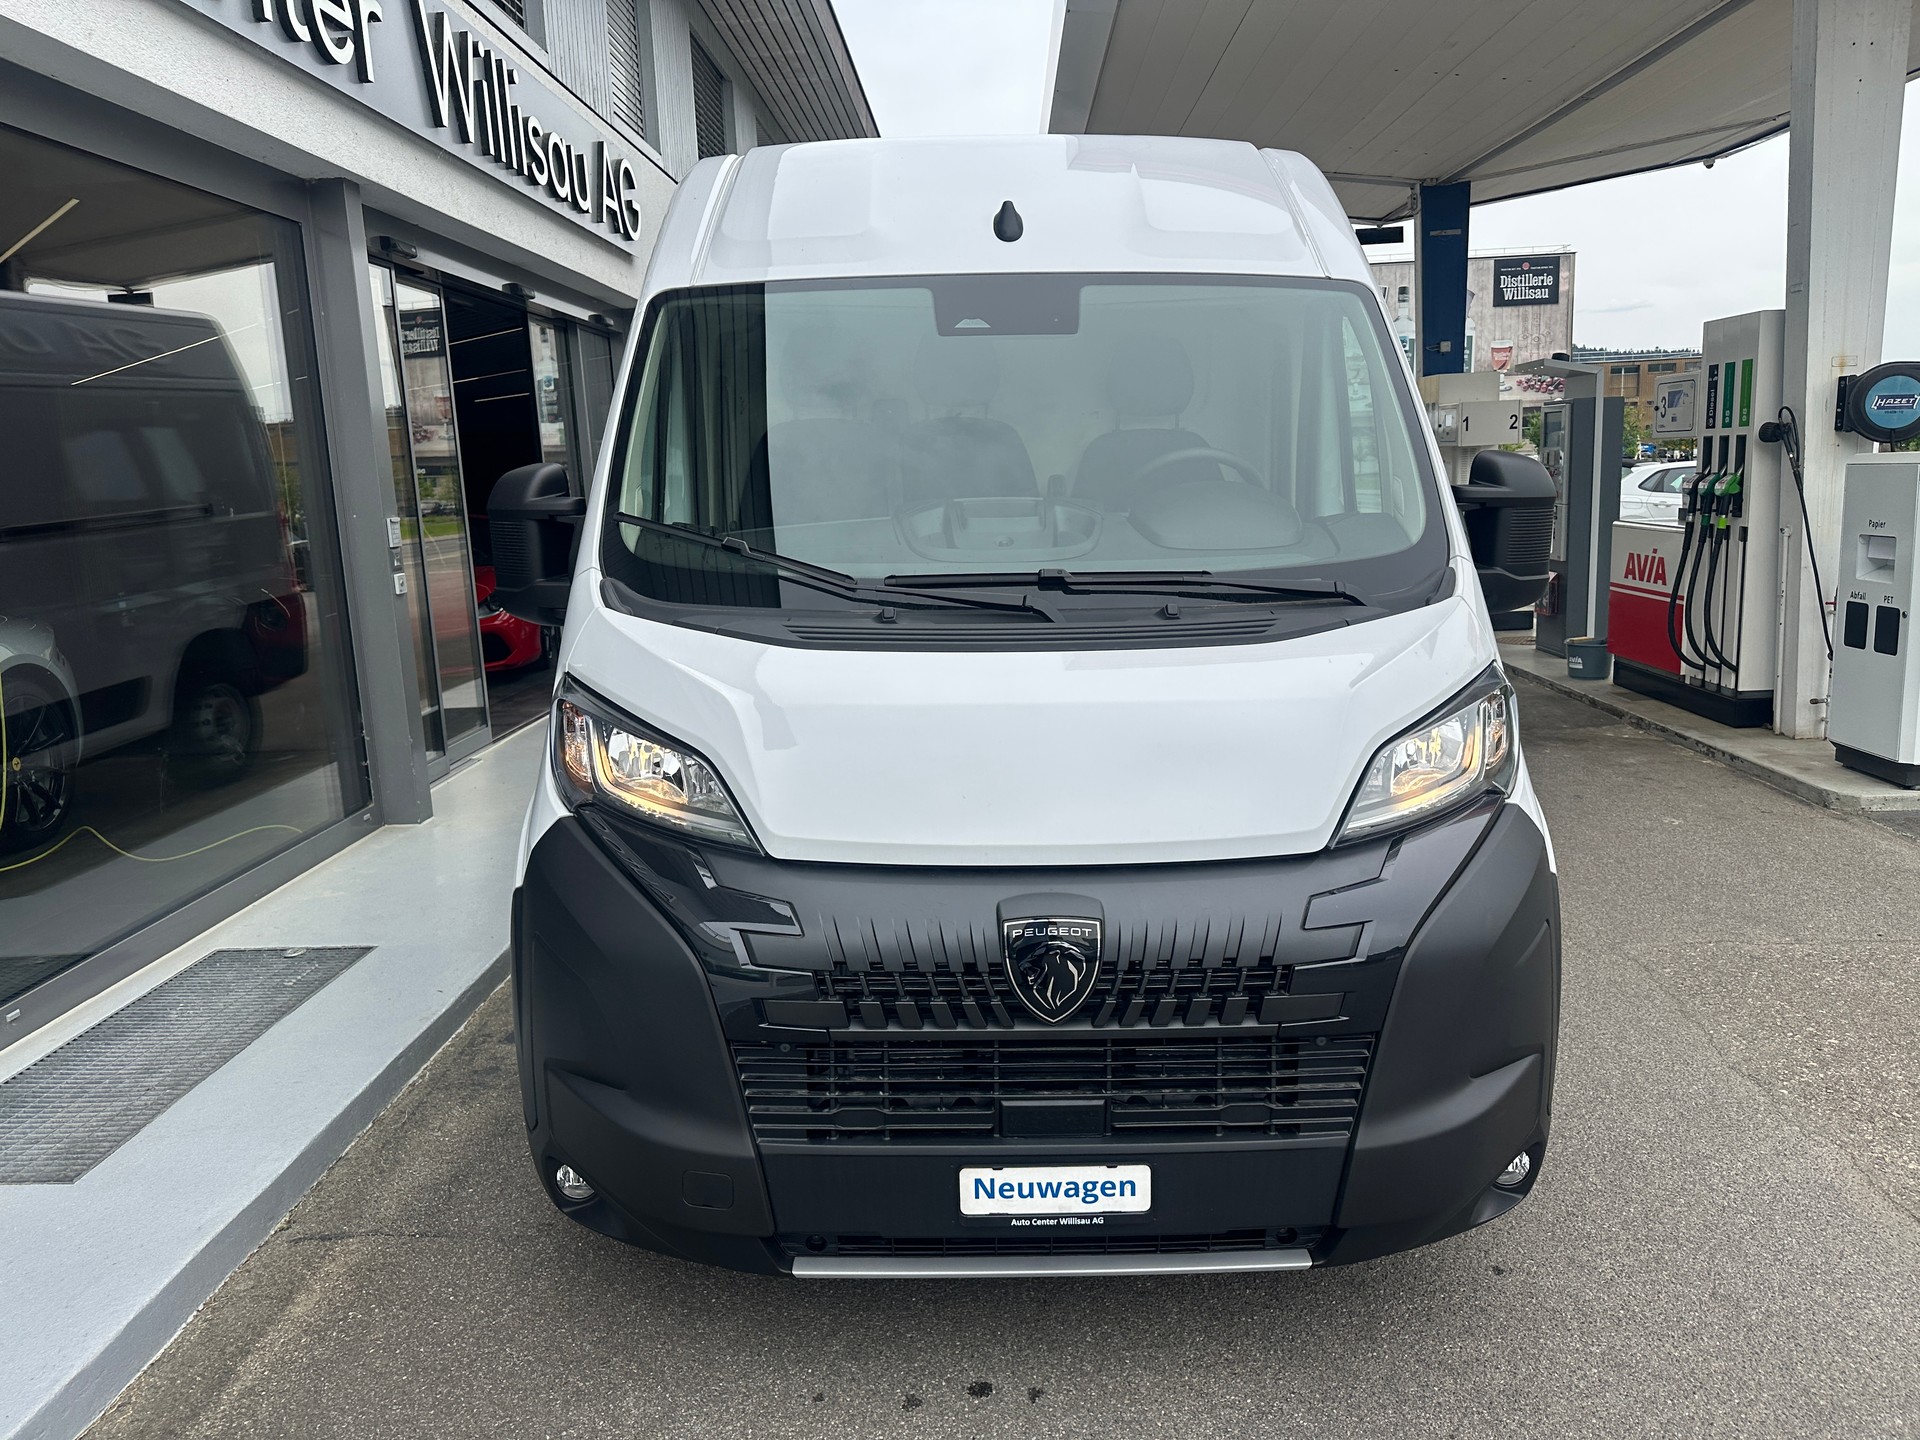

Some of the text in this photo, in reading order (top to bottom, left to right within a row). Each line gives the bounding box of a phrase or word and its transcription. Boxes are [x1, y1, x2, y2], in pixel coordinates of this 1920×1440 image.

[409, 0, 592, 214] Willisau
[594, 140, 642, 242] AG
[1499, 273, 1554, 288] Distillerie
[1502, 286, 1550, 301] Willisau
[1660, 396, 1667, 418] 3
[1462, 414, 1518, 431] 1 2
[1868, 519, 1886, 530] Papier
[1850, 590, 1894, 604] Abfall PET
[1012, 927, 1092, 939] PEUGEOT
[974, 1177, 1137, 1205] Neuwagen
[1010, 1218, 1031, 1226] Auto
[1031, 1218, 1058, 1226] Center
[1059, 1217, 1091, 1225] Willisau
